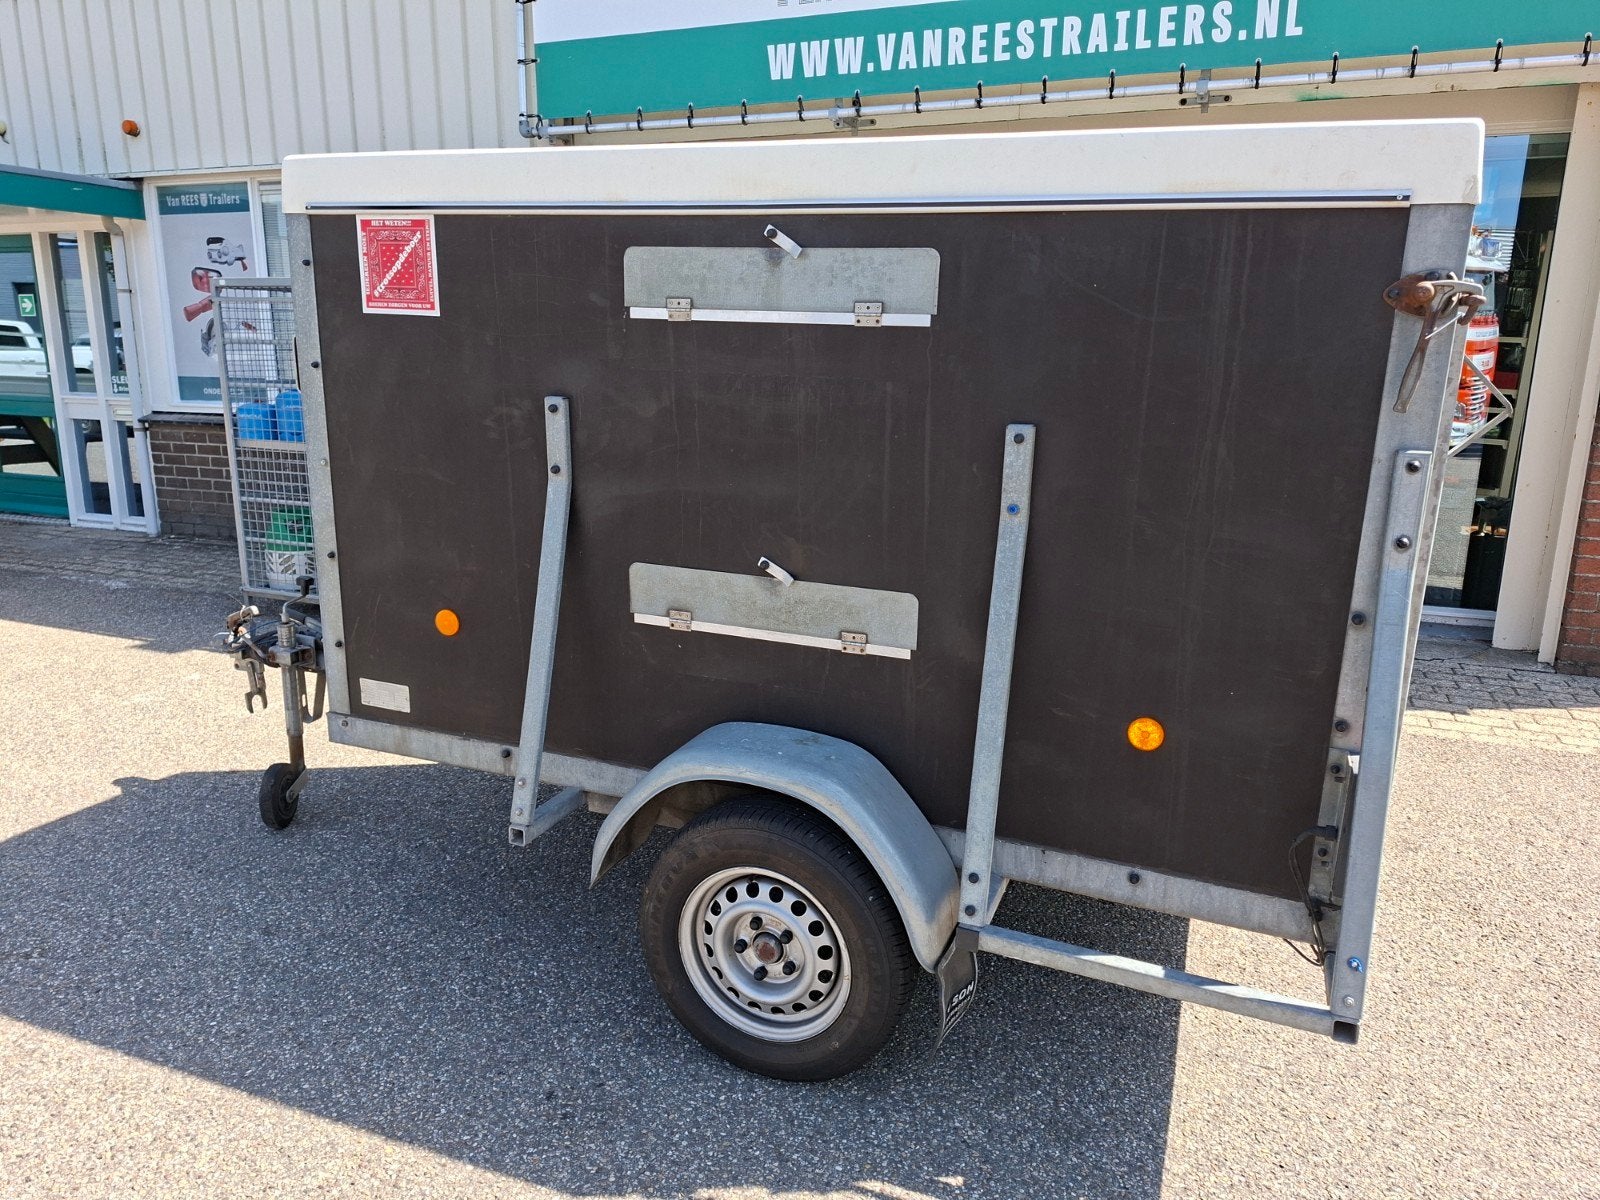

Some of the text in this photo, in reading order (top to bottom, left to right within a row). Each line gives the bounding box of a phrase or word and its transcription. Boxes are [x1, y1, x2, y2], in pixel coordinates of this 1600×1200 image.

[767, 0, 1303, 81] WWW.VANREESTRAILERS.NL
[166, 192, 240, 207] Van REES Trailers
[374, 231, 421, 298] #trotsopdeboer
